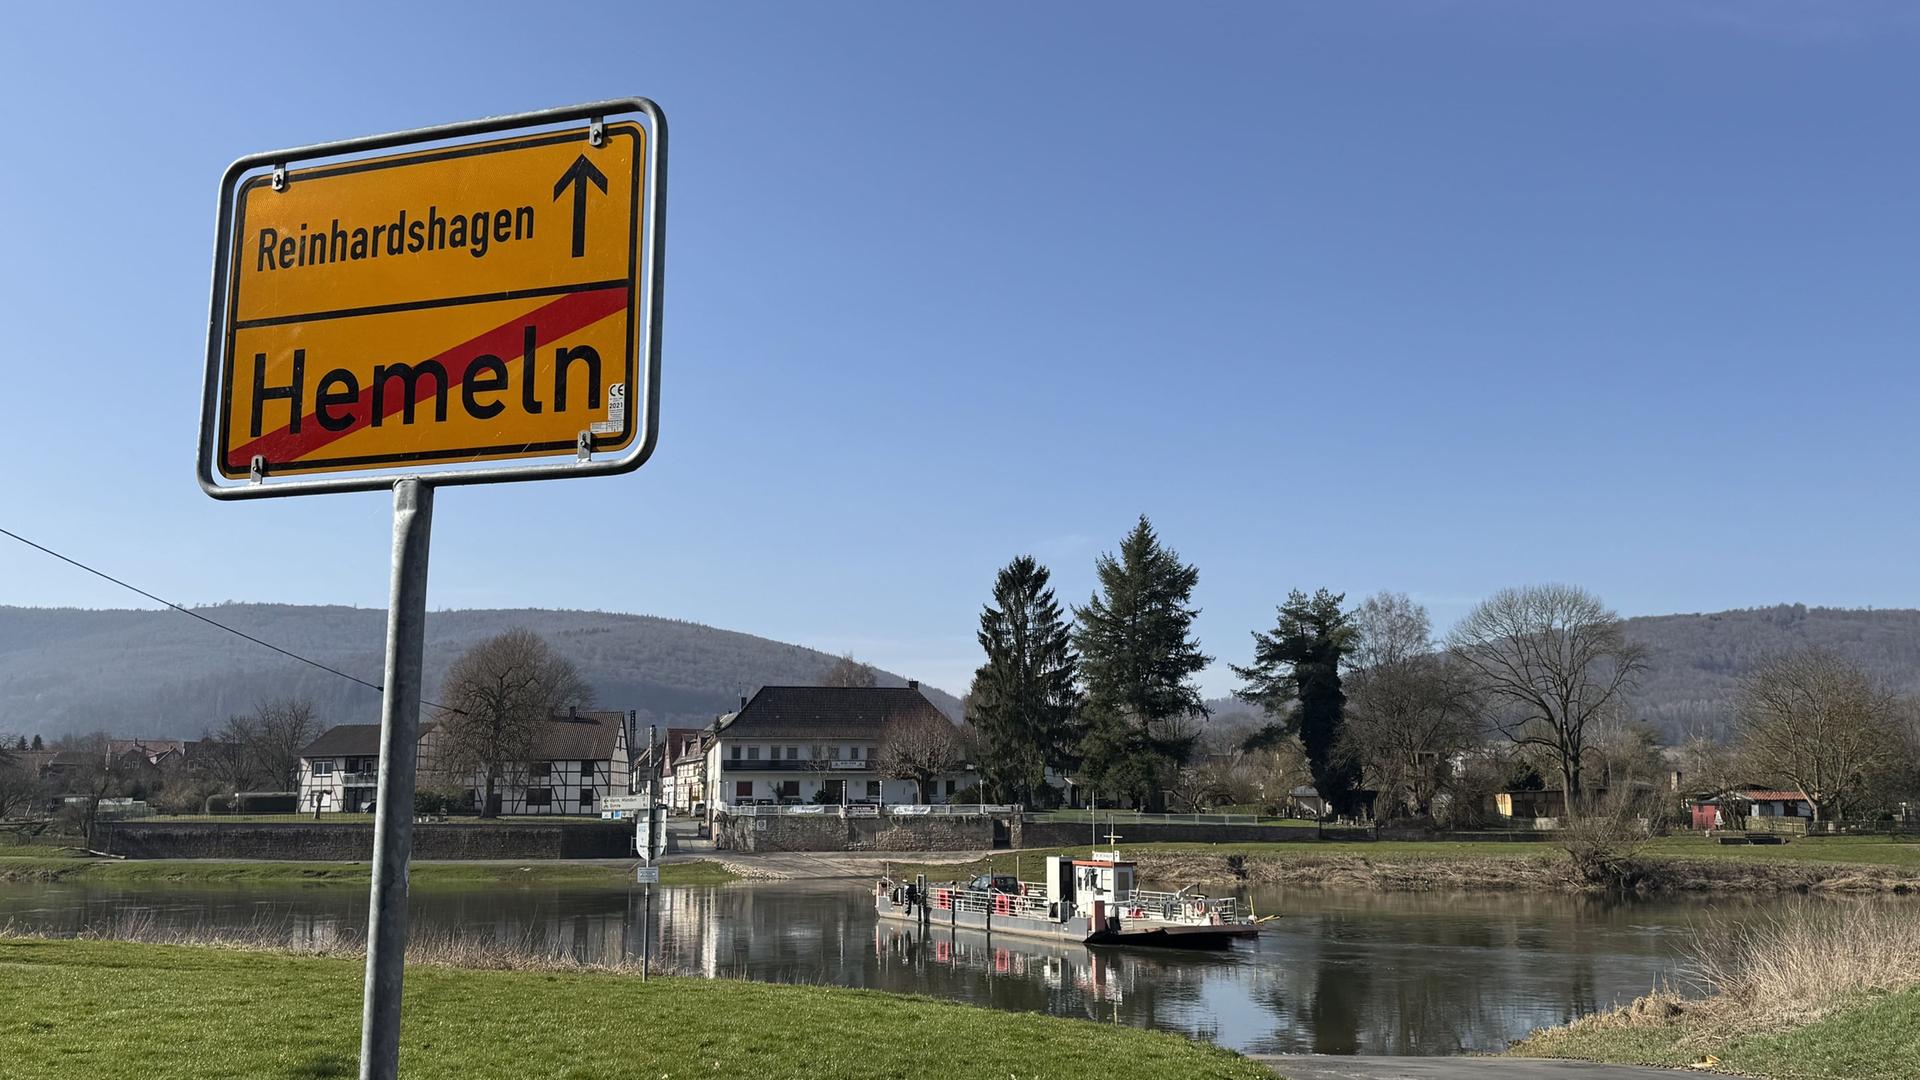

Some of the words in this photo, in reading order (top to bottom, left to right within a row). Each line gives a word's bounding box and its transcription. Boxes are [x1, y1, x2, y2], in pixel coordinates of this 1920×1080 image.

[257, 206, 534, 272] Reinhardshagen
[250, 325, 602, 438] Hemeln
[609, 384, 624, 397] CE
